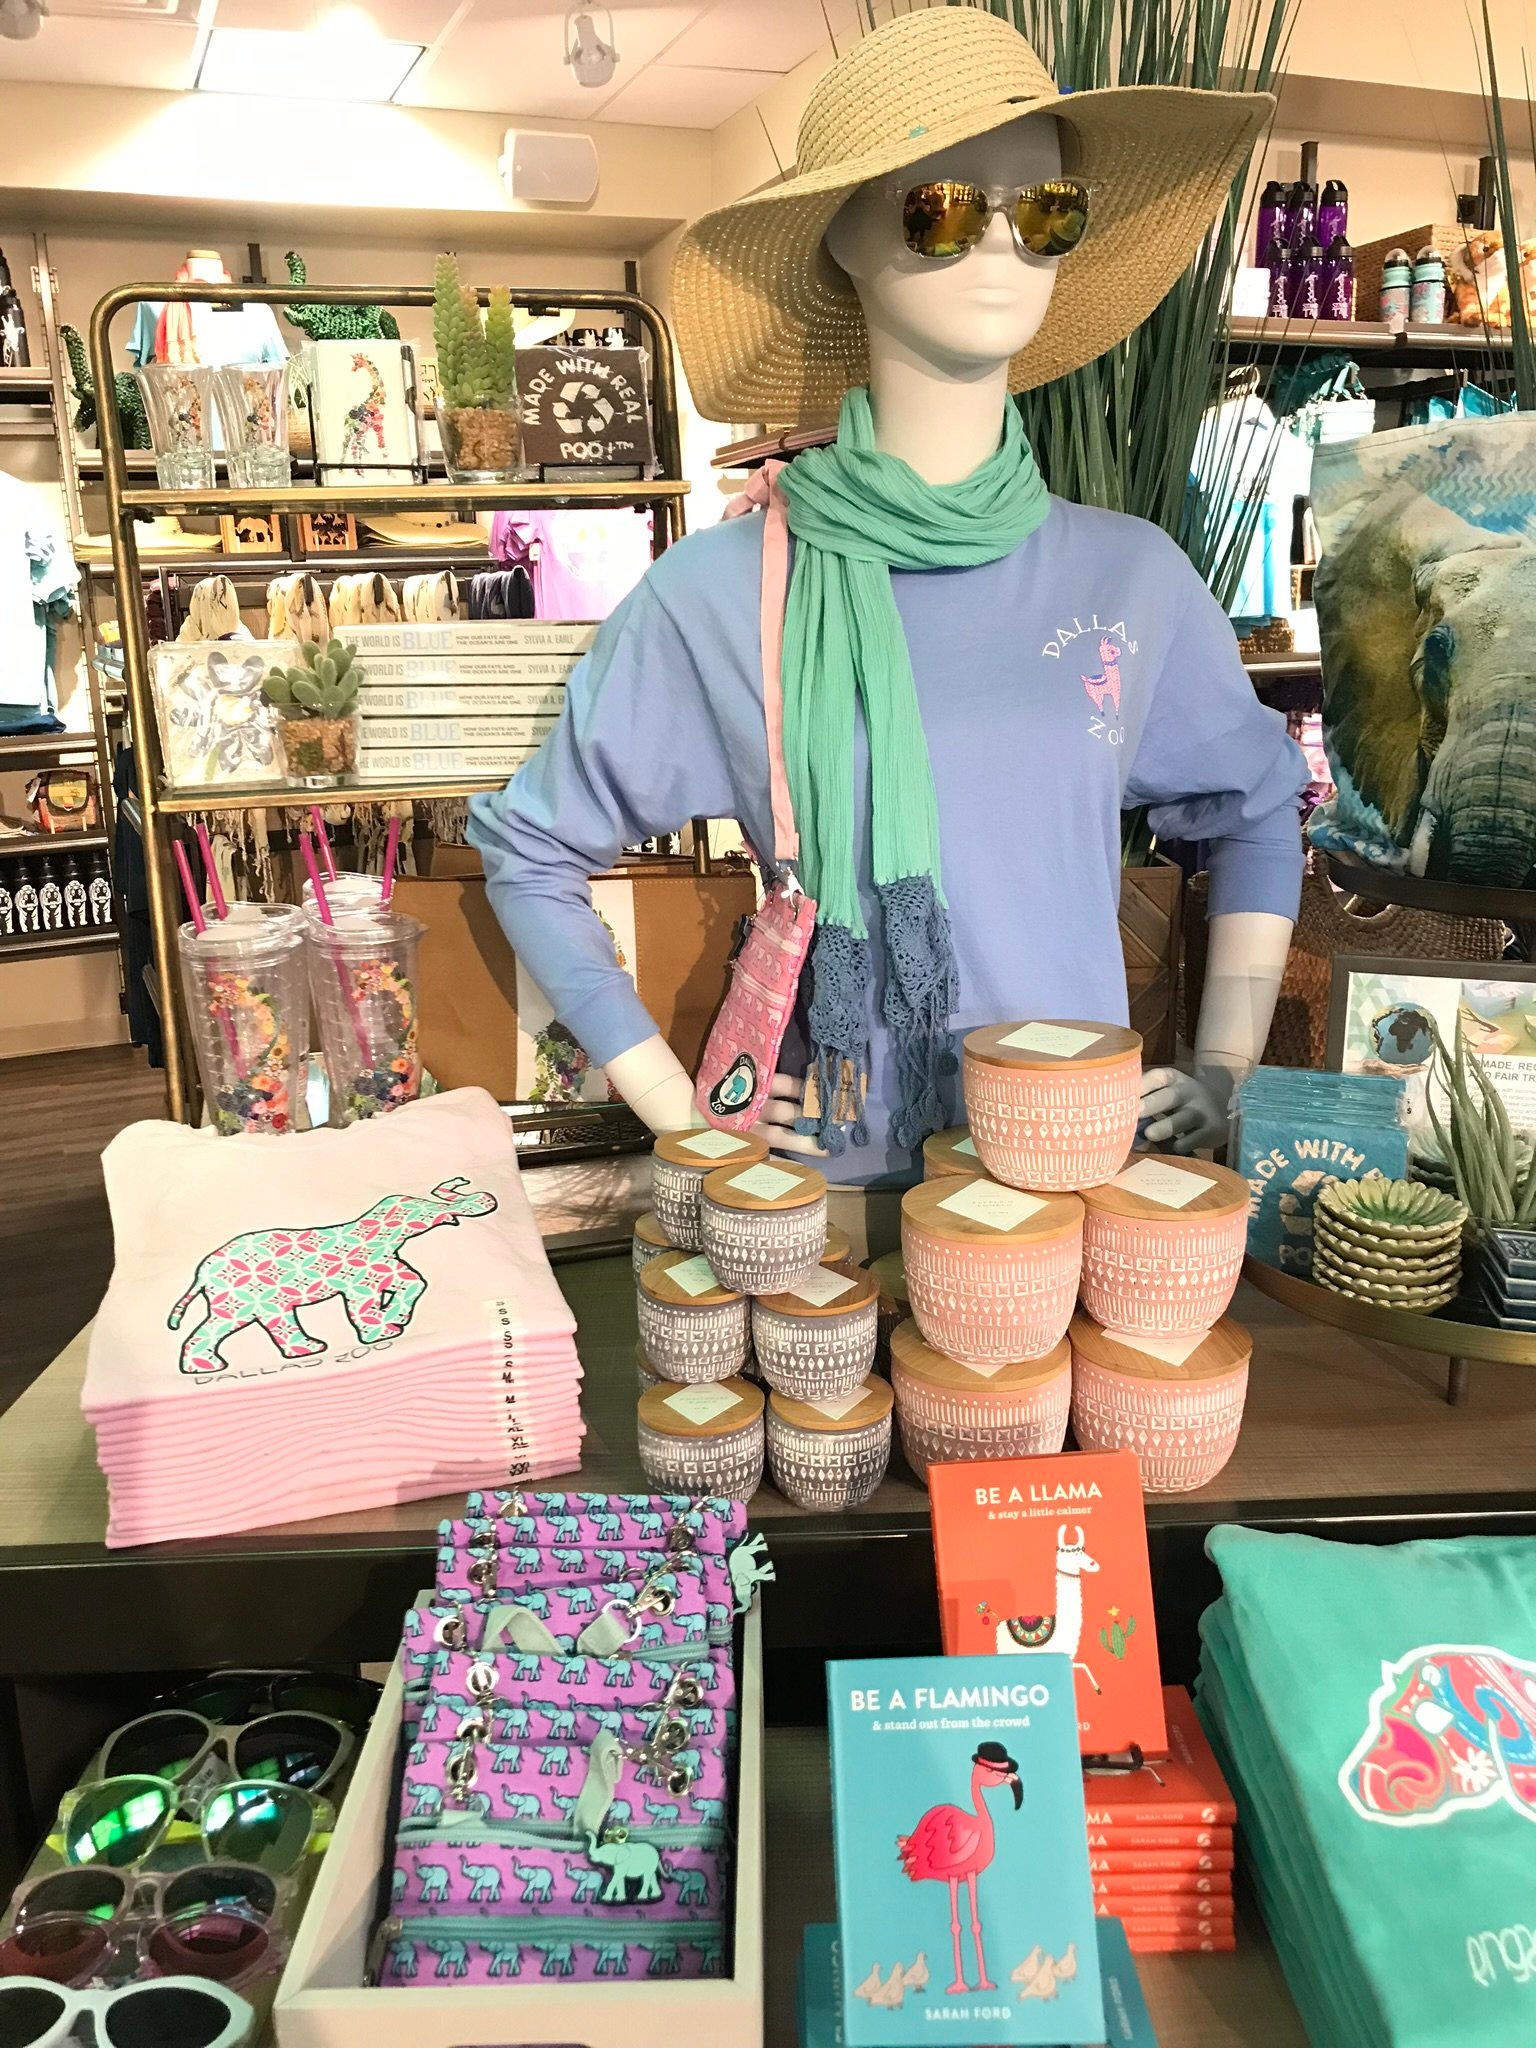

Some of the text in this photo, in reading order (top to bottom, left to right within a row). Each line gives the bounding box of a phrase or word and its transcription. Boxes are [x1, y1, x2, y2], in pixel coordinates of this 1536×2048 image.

[523, 358, 644, 425] MADE WITH REAL
[345, 631, 454, 650] THE WORLD IS BLUE
[524, 634, 546, 644] SYLVIA
[1041, 614, 1139, 659] DALLAS
[364, 664, 394, 676] WORLD
[396, 664, 404, 676] IS
[528, 664, 549, 674] SYLVIA
[364, 695, 394, 706] WORLD
[396, 695, 404, 706] IS
[528, 695, 548, 704] SYLVIA
[370, 727, 398, 739] WORLD
[400, 727, 408, 738] IS
[410, 723, 461, 741] BLUE
[1087, 715, 1125, 745] ZOO
[360, 752, 462, 771] HE WORLD IS BLUE
[1495, 1072, 1519, 1081] FAIR
[711, 1098, 726, 1114] ZOO
[1295, 1138, 1366, 1172] WITH
[501, 1317, 511, 1325] S
[503, 1331, 512, 1341] S
[335, 1341, 393, 1363] ZOO
[975, 1481, 1103, 1505] BE A LLAMA
[988, 1511, 996, 1520] &
[998, 1509, 1020, 1520] stay
[1029, 1507, 1054, 1518] little
[1056, 1506, 1092, 1516] calmer
[850, 1684, 1050, 1712] BE A FLAMINGO
[872, 1715, 1030, 1731] & stand out from the crowd
[925, 2005, 1012, 2021] SARAH FORD
